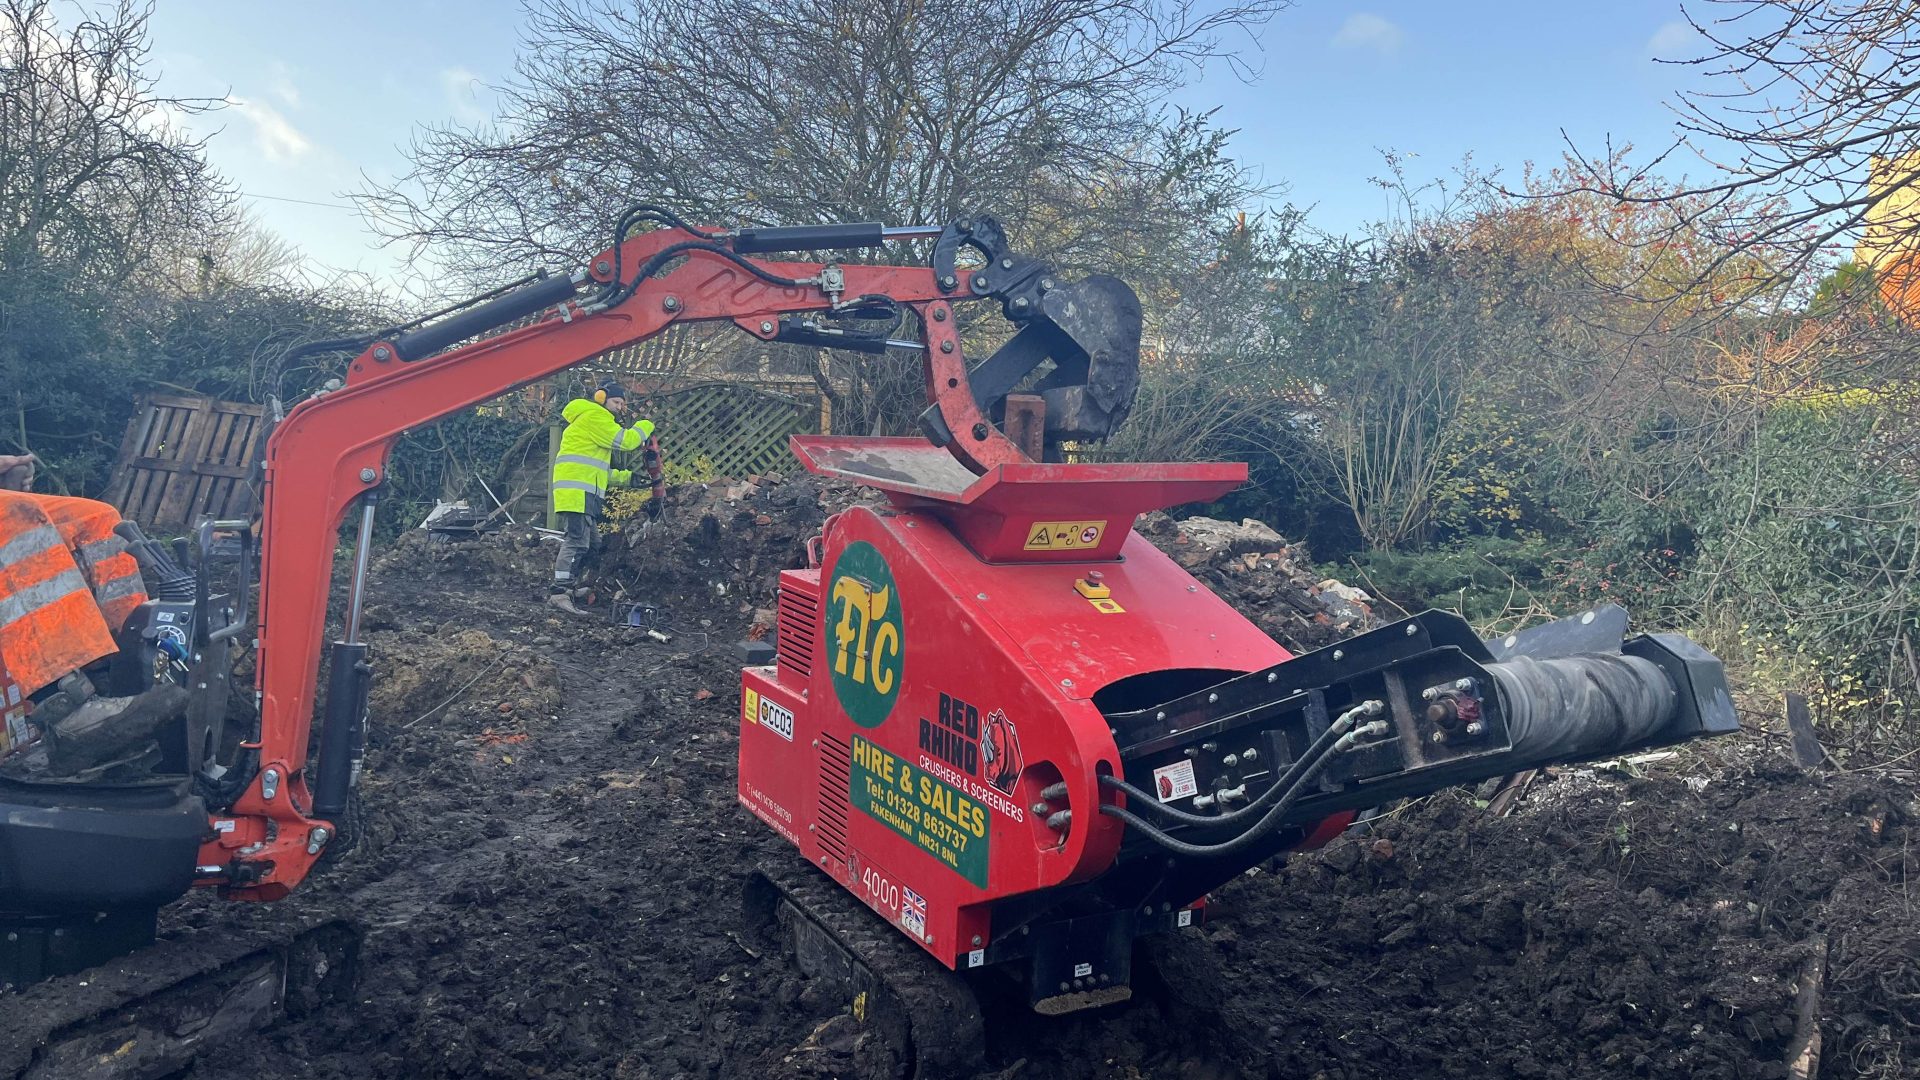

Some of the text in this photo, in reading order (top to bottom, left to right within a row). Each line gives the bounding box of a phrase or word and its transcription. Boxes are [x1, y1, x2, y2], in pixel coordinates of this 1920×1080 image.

[919, 717, 977, 776] RHINO
[939, 692, 978, 740] RED
[854, 737, 985, 838] HIRE & SALES
[865, 776, 967, 852] Tel: 01328 863737
[920, 755, 1023, 822] CRUSHERS & SCREENERS
[870, 801, 958, 867] FAKENHAM NR21 8NL
[863, 867, 898, 910] 4000
